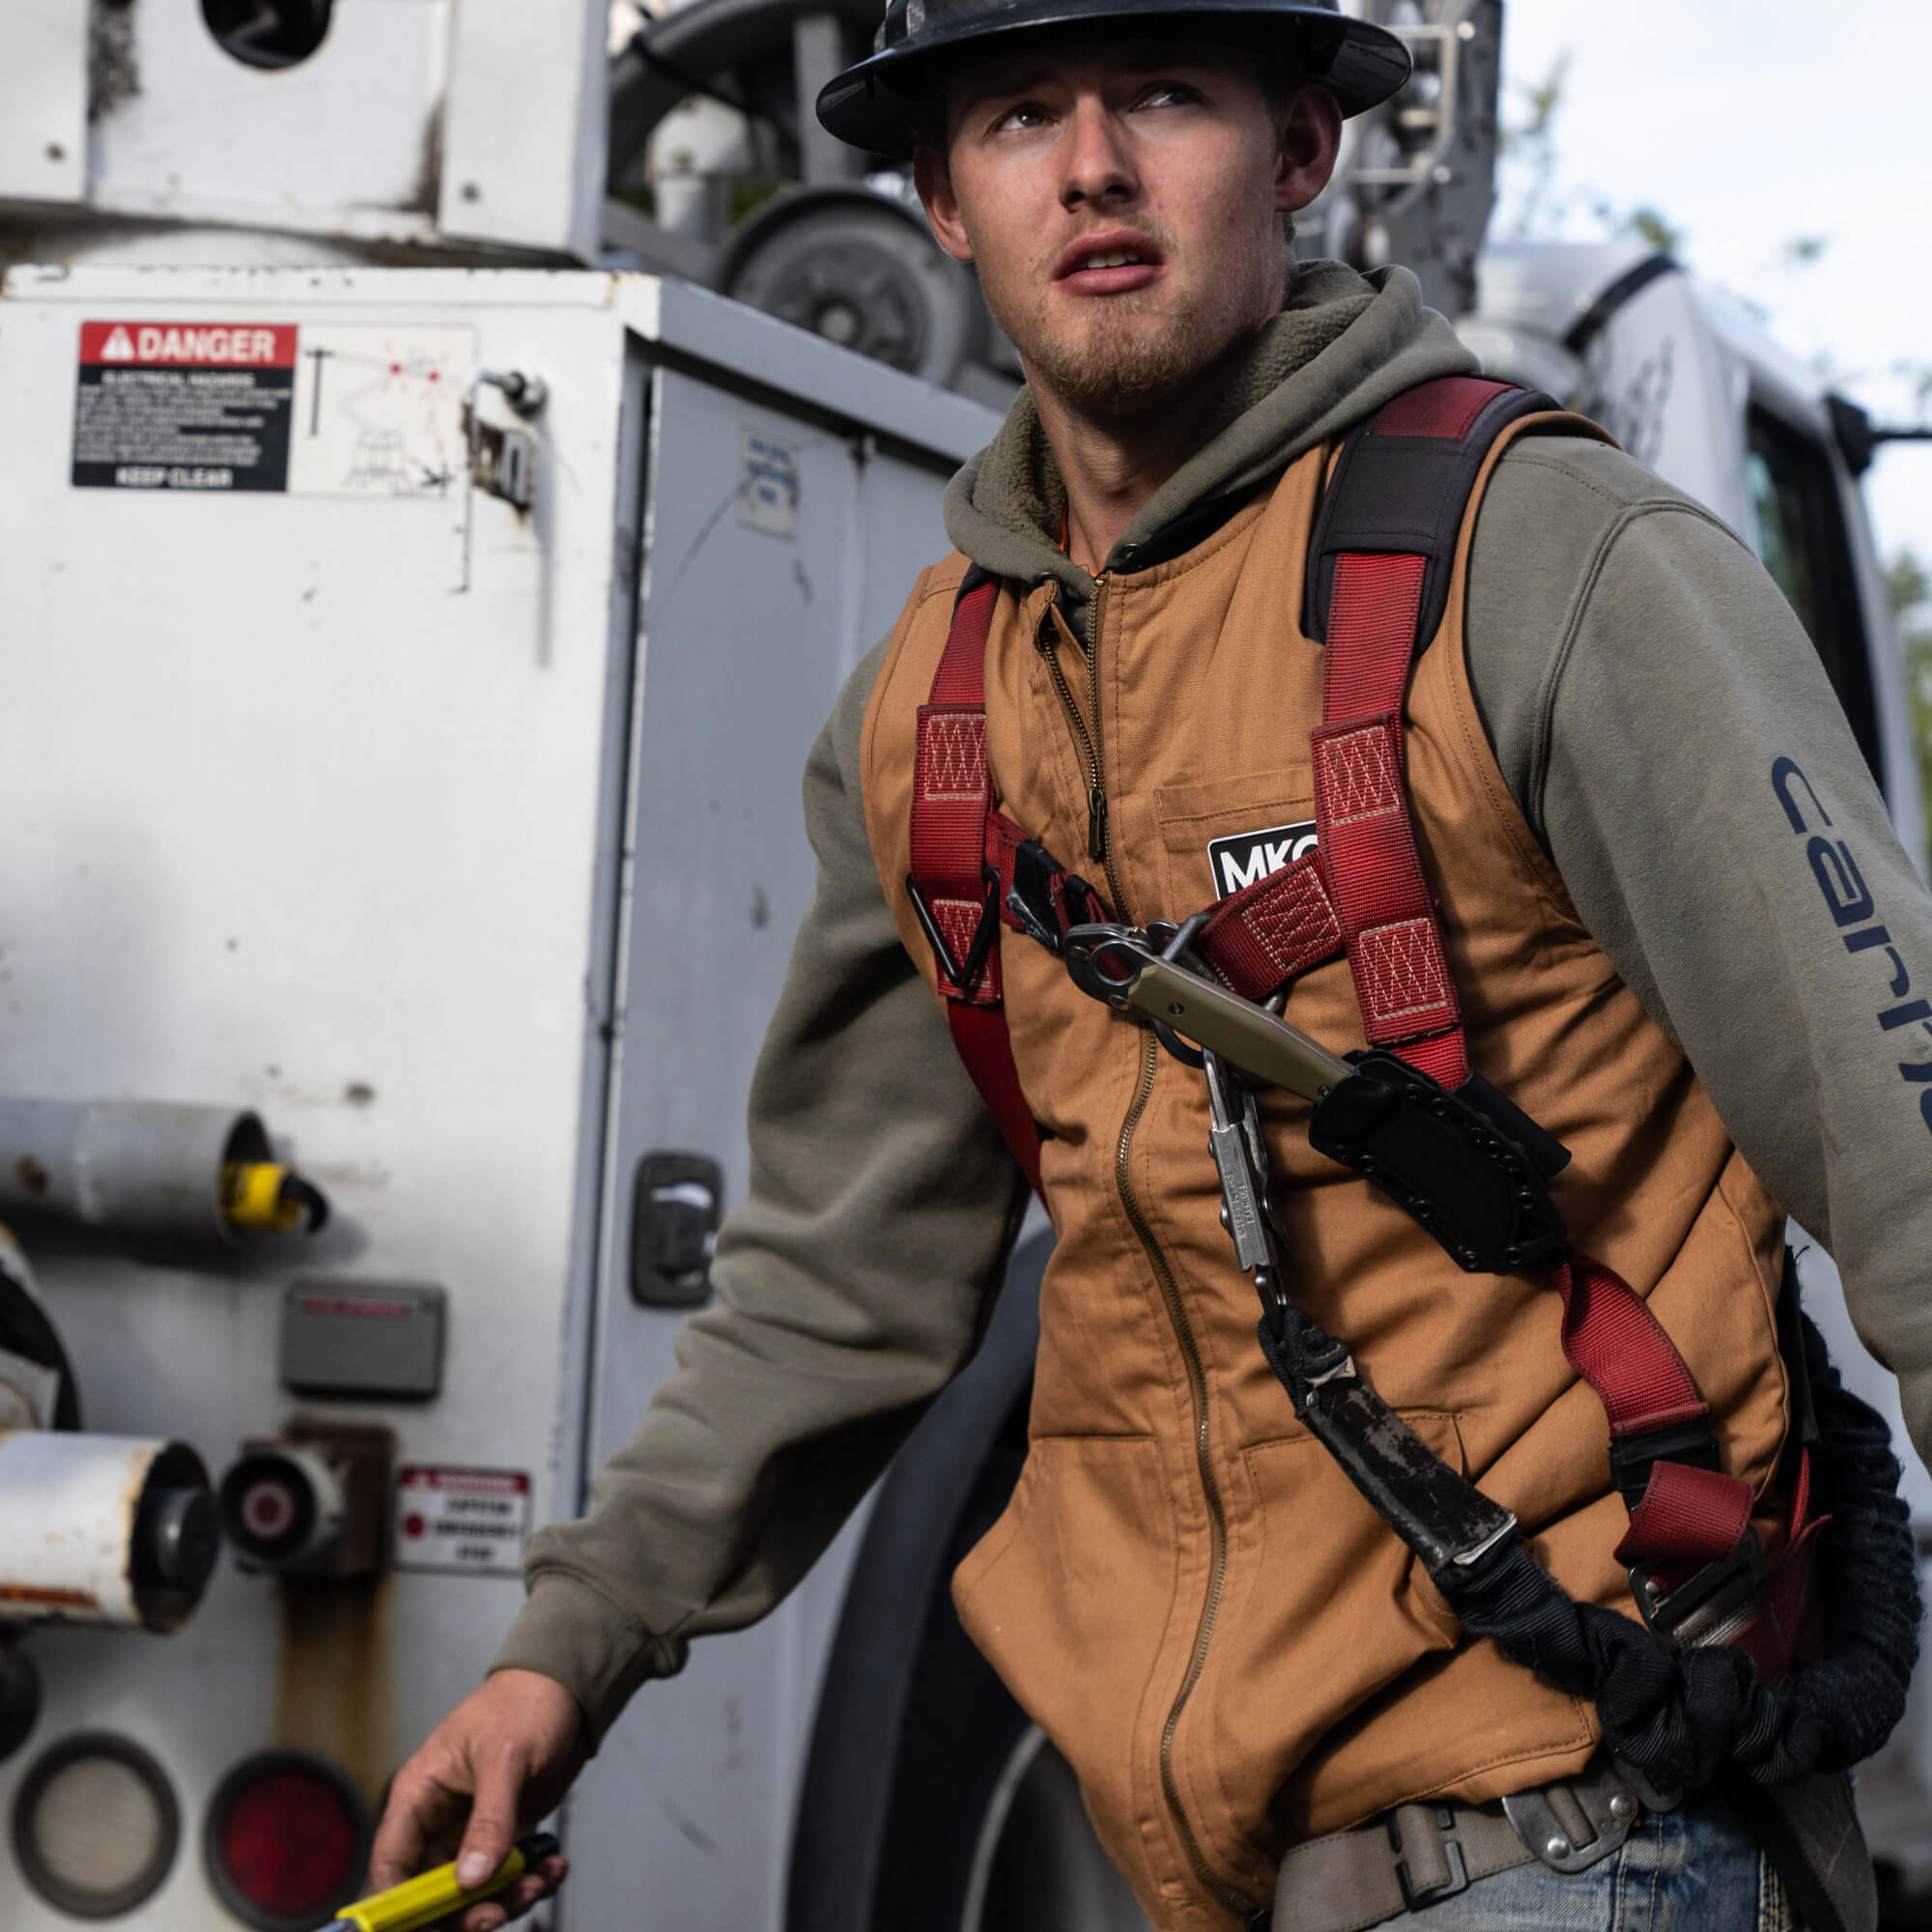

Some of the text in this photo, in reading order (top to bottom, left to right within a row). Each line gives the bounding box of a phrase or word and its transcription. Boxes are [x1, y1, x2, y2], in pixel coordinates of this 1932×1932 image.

[137, 327, 275, 363] DANGER
[116, 466, 234, 488] KEEP CLEAR
